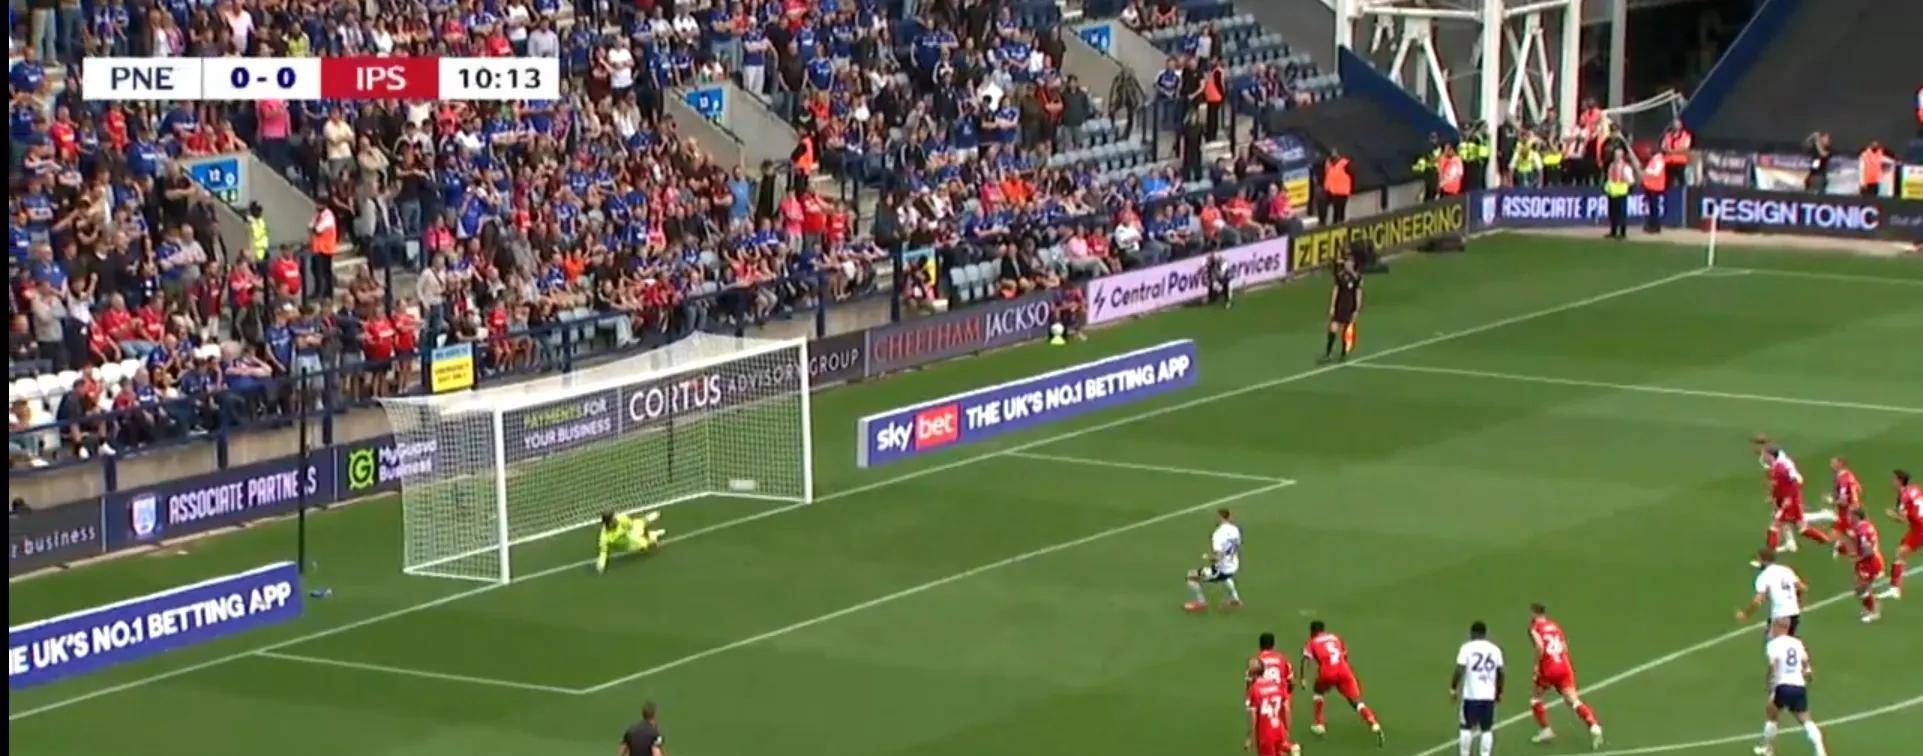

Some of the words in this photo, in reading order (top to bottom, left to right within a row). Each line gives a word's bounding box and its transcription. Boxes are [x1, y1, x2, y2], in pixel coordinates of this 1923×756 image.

[1502, 195, 1582, 218] ASSOCIATE
[1587, 195, 1665, 218] PANES
[1702, 198, 1797, 225] DESIGN
[1801, 203, 1879, 230] TONIC
[1110, 275, 1166, 308] Central
[1168, 263, 1213, 296] Powe
[1225, 251, 1281, 285] ervices
[874, 313, 982, 362] CHEETHAM
[984, 300, 1050, 346] JACKSO
[629, 374, 722, 421] CORTUS
[726, 360, 803, 394] ADVISORY
[810, 349, 860, 377] GROUP
[966, 404, 1001, 430] THE
[1045, 381, 1083, 411] NO.1
[1085, 364, 1156, 401] BETTING
[1157, 354, 1191, 381] APP
[583, 398, 607, 417] FOR
[524, 429, 556, 449] YOUR
[557, 416, 611, 443] BUSINESS
[876, 420, 912, 452] sky
[917, 408, 955, 440] bet
[168, 481, 244, 523] ASSOCIATE
[247, 465, 317, 507] PARTNES
[22, 526, 96, 555] business
[92, 616, 144, 653] NO.1
[148, 594, 246, 640] BETTING
[249, 581, 292, 615] APP
[1471, 652, 1496, 672] 26
[1785, 647, 1798, 667] 8
